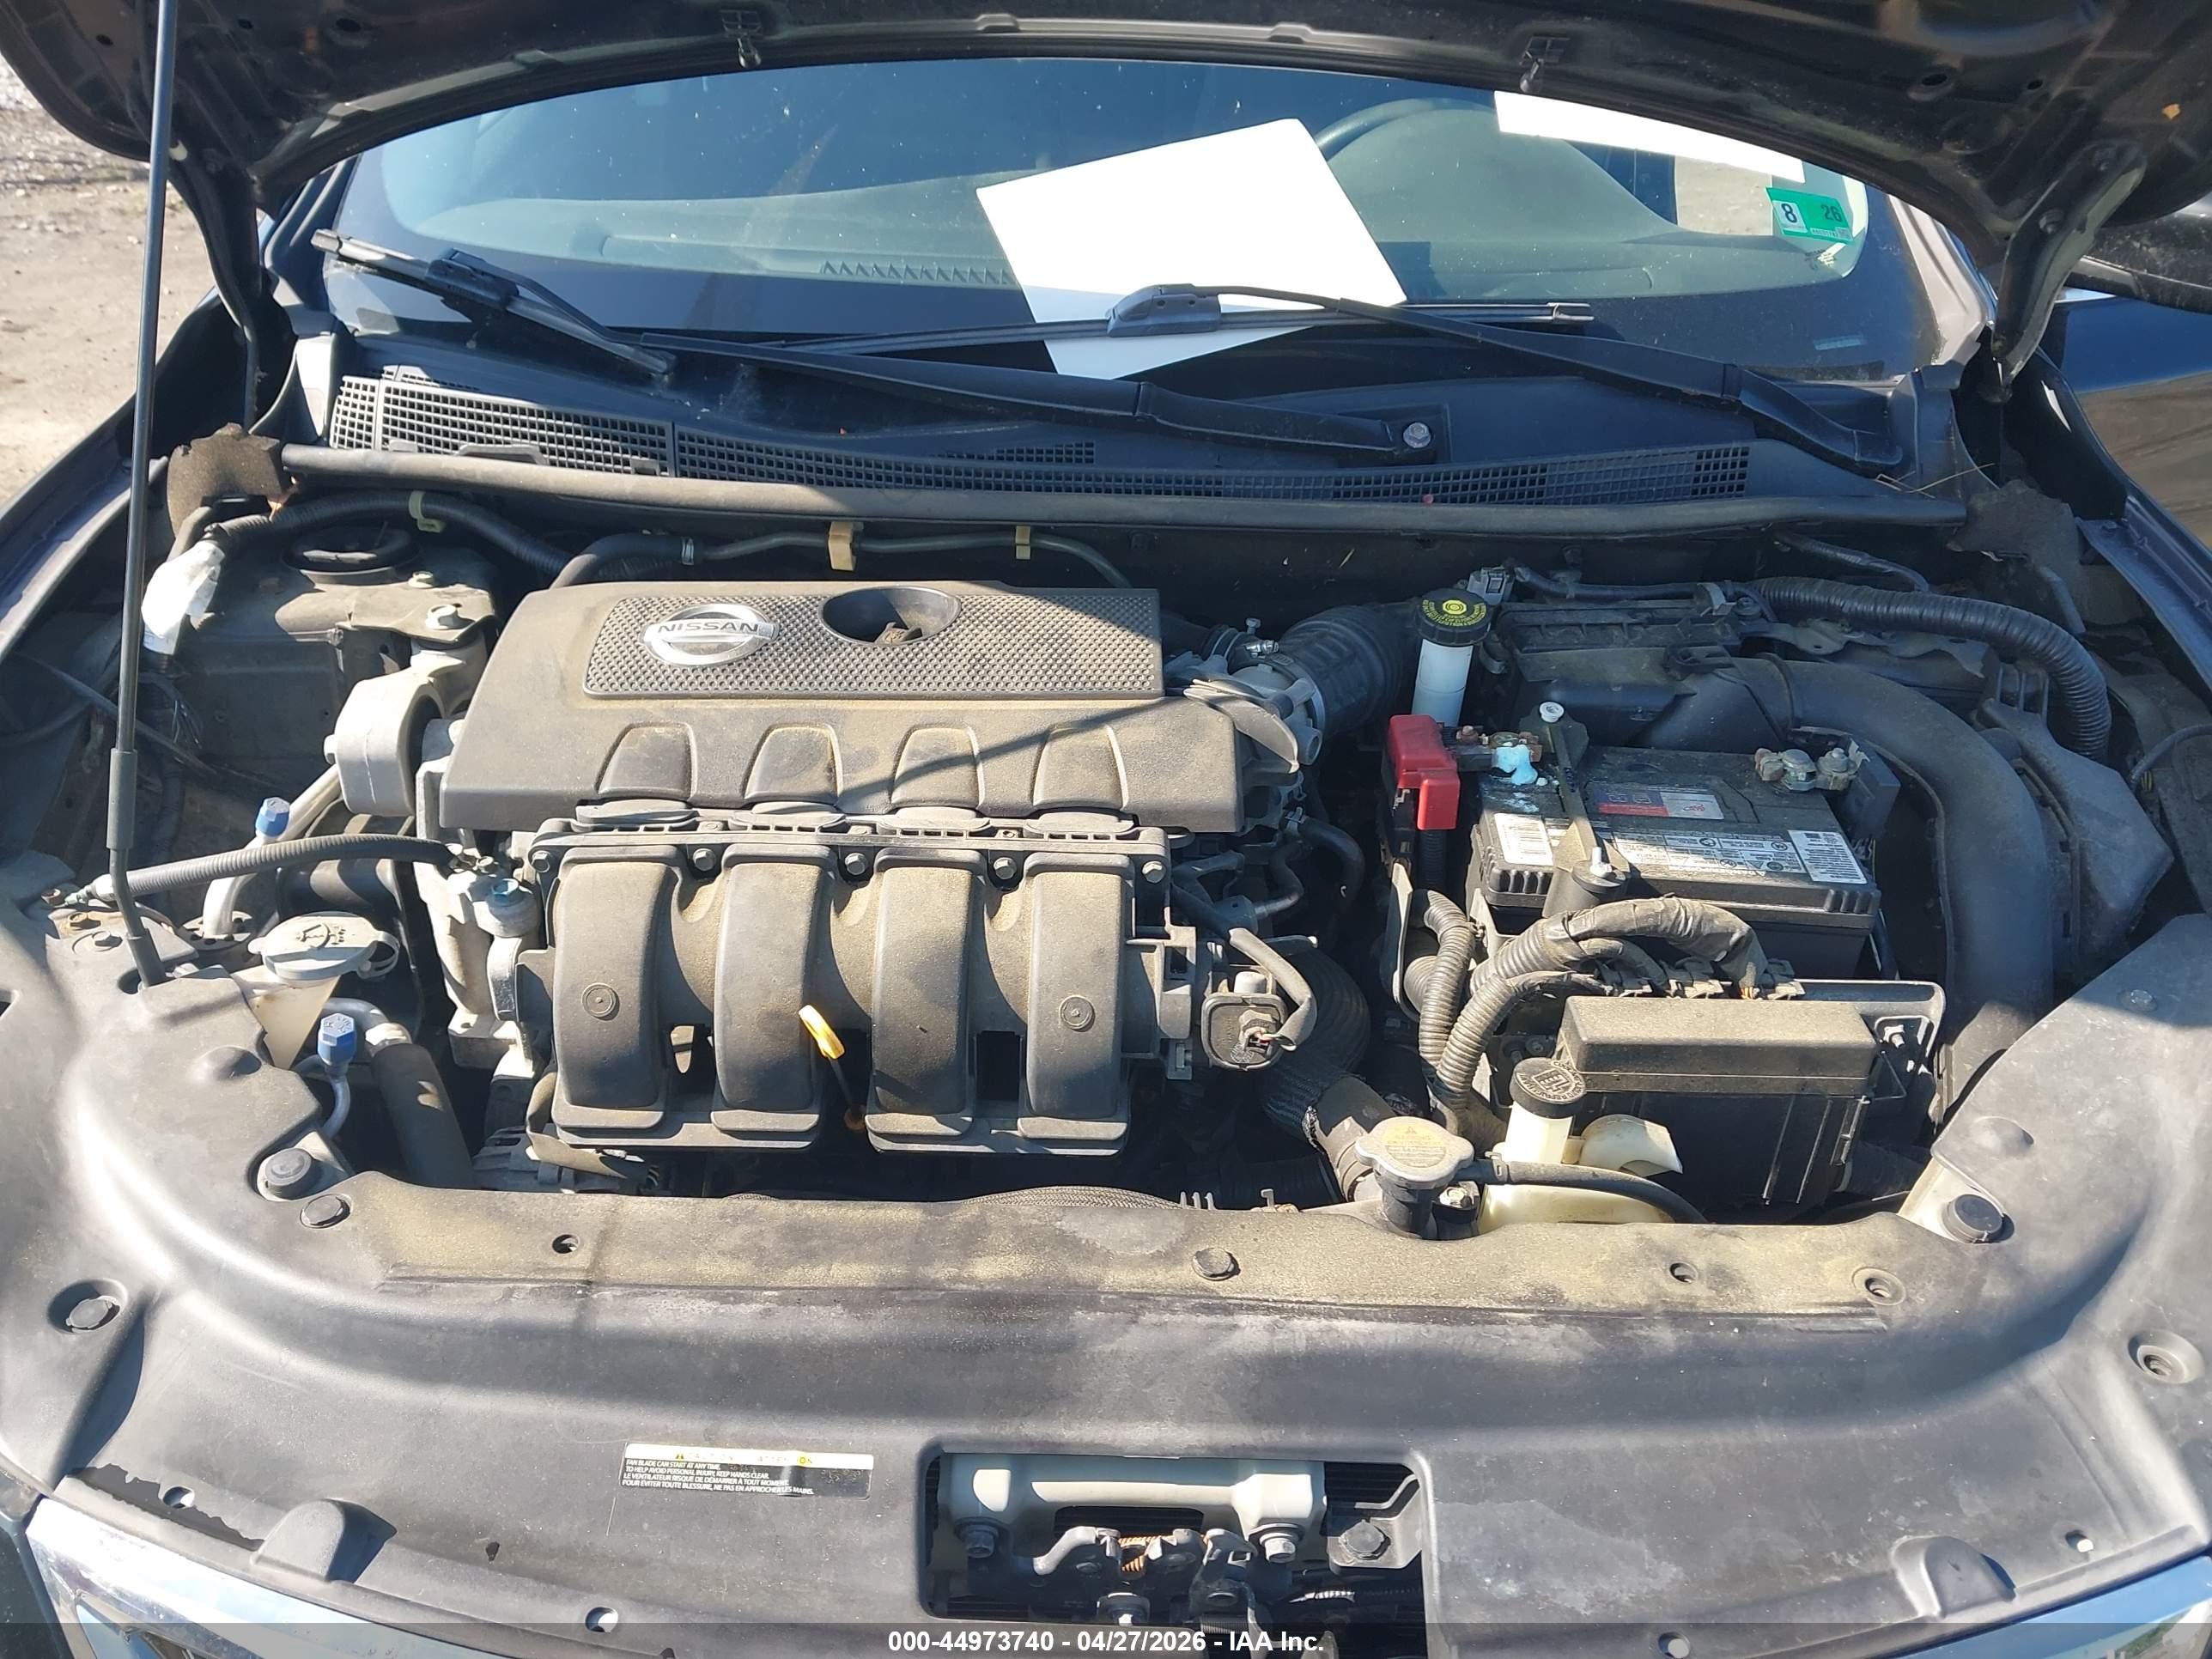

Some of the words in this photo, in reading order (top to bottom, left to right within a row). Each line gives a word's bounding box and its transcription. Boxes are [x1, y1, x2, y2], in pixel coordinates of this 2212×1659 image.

[1780, 203, 1798, 223] 8
[658, 622, 758, 633] NISSAN
[666, 1468, 696, 1476] PERSONAL
